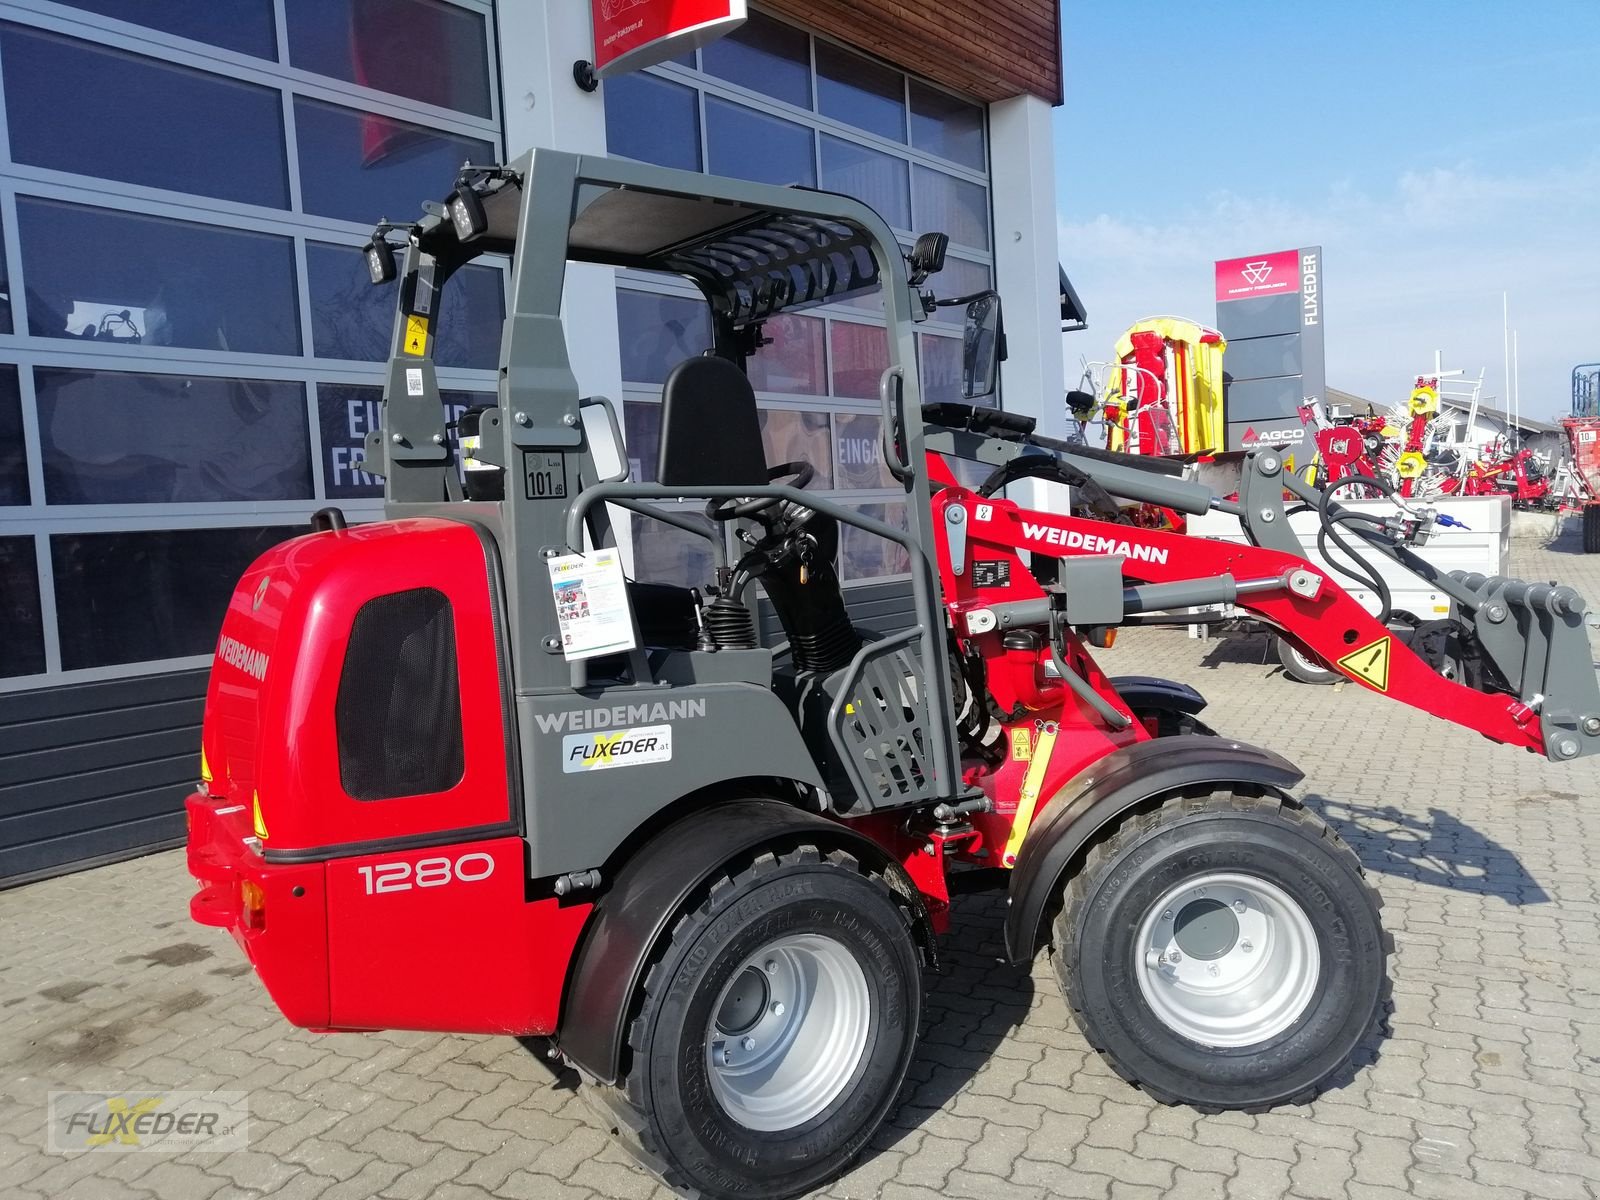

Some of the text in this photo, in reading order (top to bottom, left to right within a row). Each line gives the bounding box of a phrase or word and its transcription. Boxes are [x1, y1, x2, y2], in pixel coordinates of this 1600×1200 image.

[1303, 254, 1318, 326] FLIXEDER
[838, 437, 881, 465] EINGA
[1259, 428, 1305, 441] AGCO
[528, 471, 552, 496] 101
[1021, 520, 1169, 565] WEIDEMANN
[218, 633, 270, 683] WEIDEMANN
[534, 697, 707, 735] WEIDEMANN
[357, 851, 496, 896] 1280
